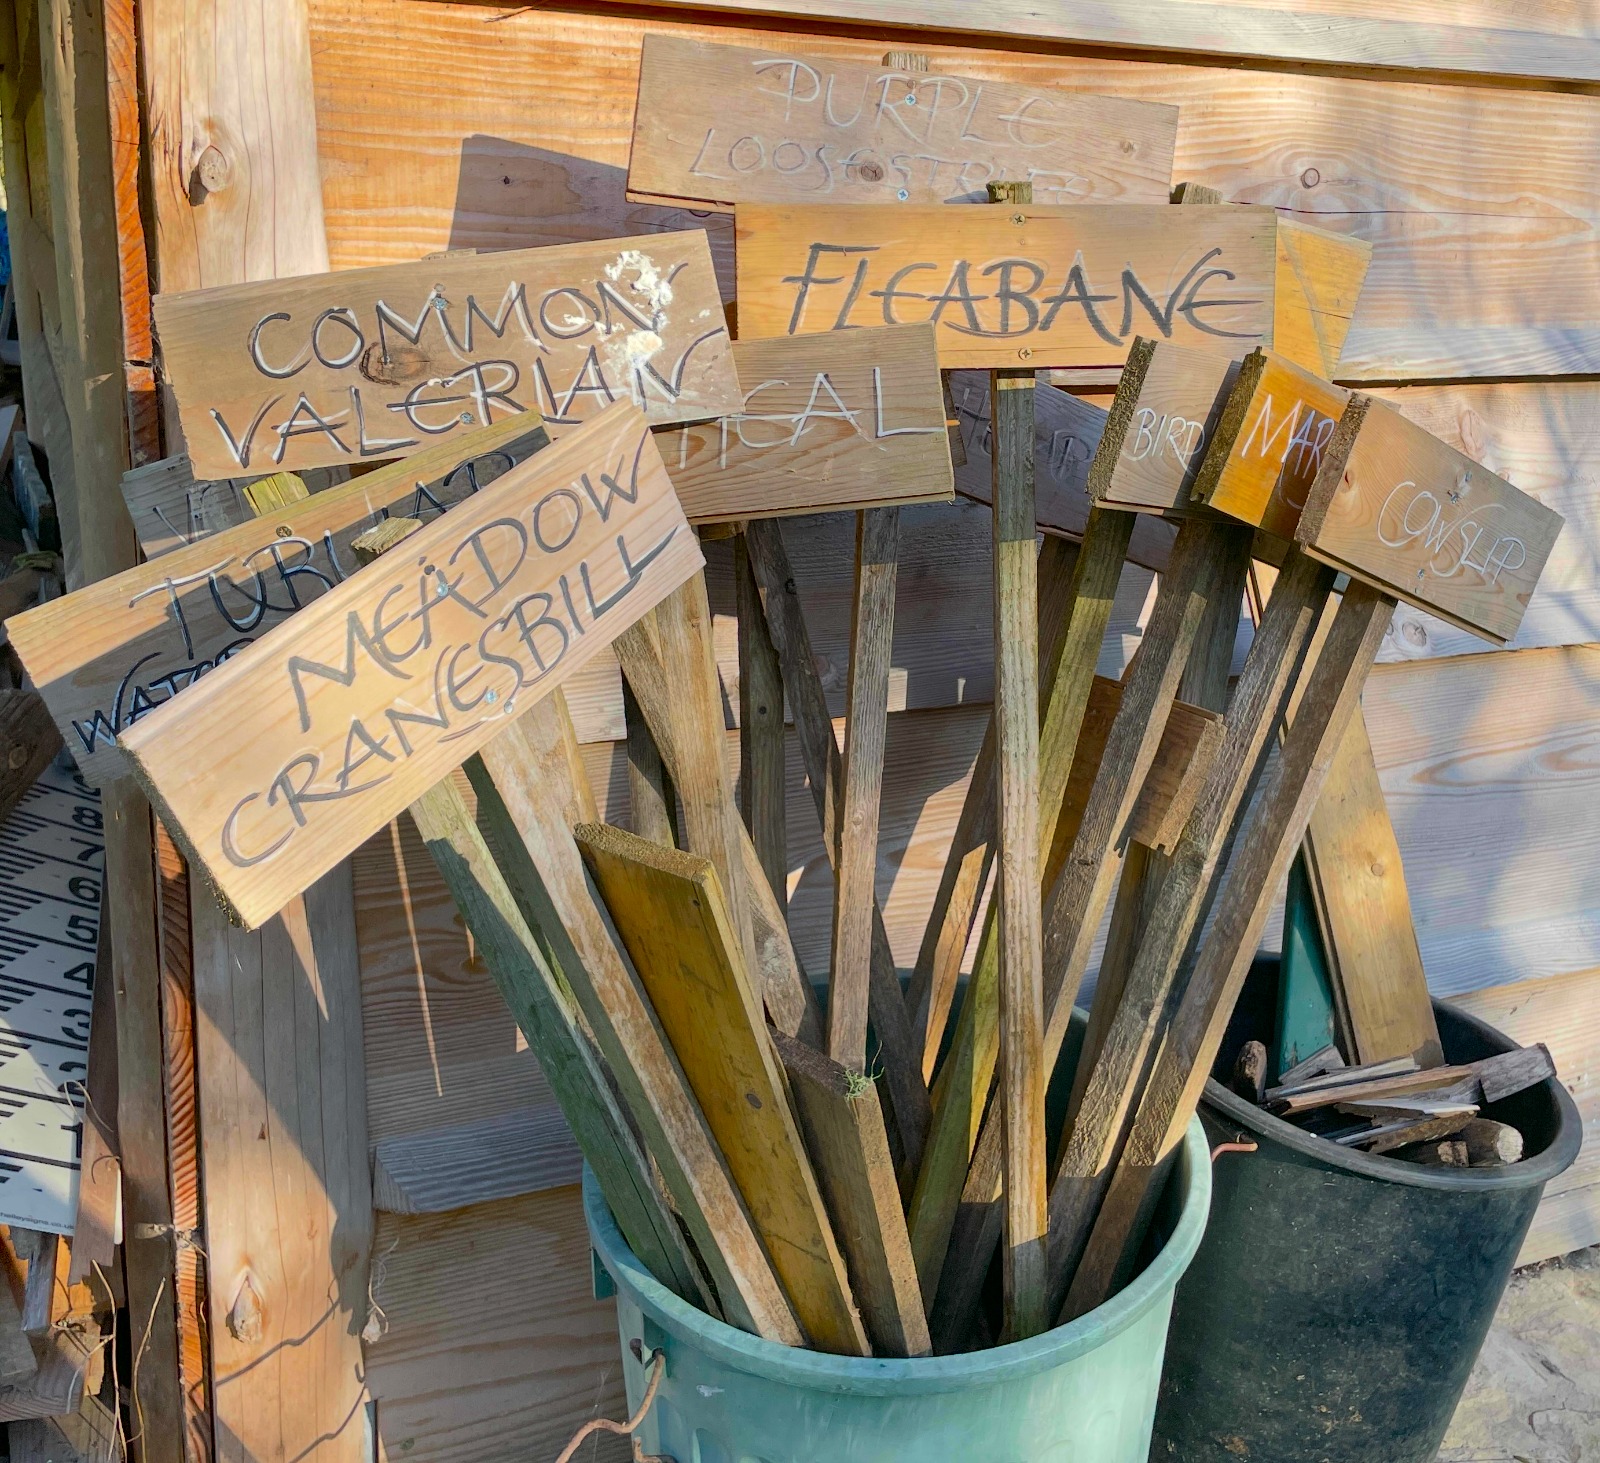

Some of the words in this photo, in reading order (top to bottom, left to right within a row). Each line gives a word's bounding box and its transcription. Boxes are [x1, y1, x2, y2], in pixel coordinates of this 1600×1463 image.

[752, 57, 1076, 149] PURPLE
[247, 262, 689, 380] COMMON
[782, 242, 1264, 346] FLEABANE
[209, 326, 725, 469] VALERIAN
[1121, 407, 1206, 479] BIRD
[129, 451, 517, 660] TUBA
[1378, 480, 1526, 585] COWSLIP
[289, 428, 646, 734] MEADOW
[221, 526, 679, 868] CRANESBILL
[70, 837, 105, 861] 7
[72, 806, 103, 829] 8
[65, 915, 98, 944] 5
[69, 877, 101, 903] 6
[64, 962, 94, 991] 4
[61, 1009, 90, 1042] 3
[61, 1121, 84, 1159] 1
